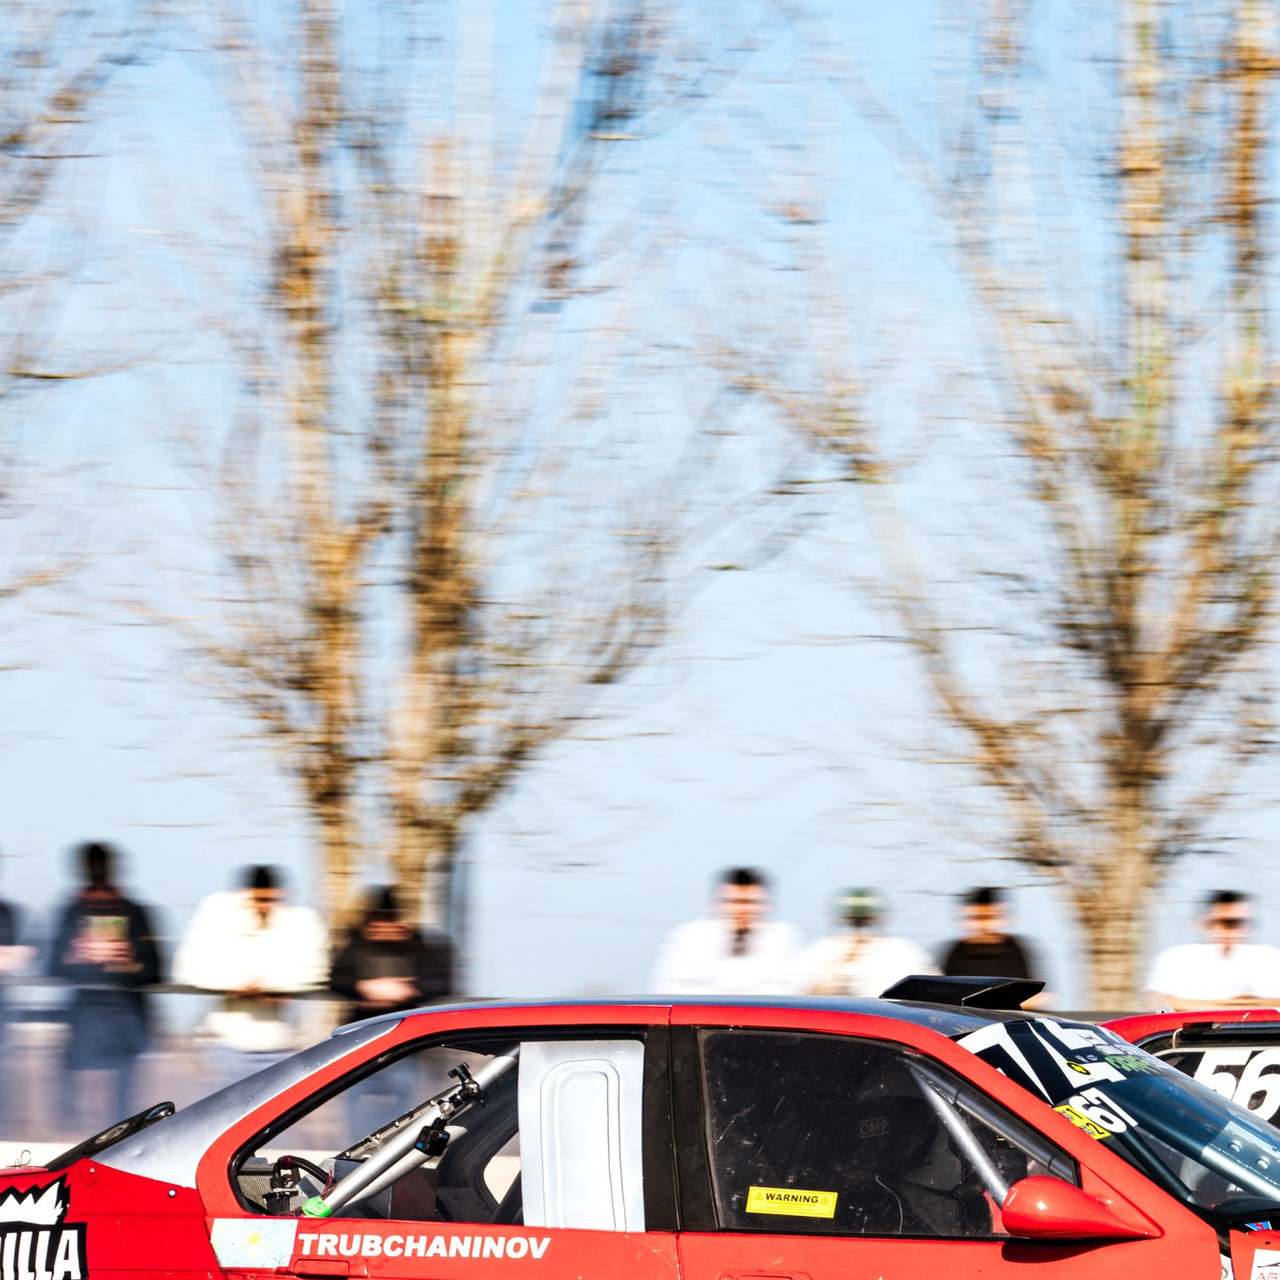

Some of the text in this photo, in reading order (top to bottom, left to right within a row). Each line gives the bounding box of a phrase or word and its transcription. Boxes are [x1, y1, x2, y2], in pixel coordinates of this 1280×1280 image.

[1068, 1087, 1138, 1133] 67
[766, 1193, 819, 1204] WARNING
[298, 1233, 551, 1259] TRUBCHANINOV
